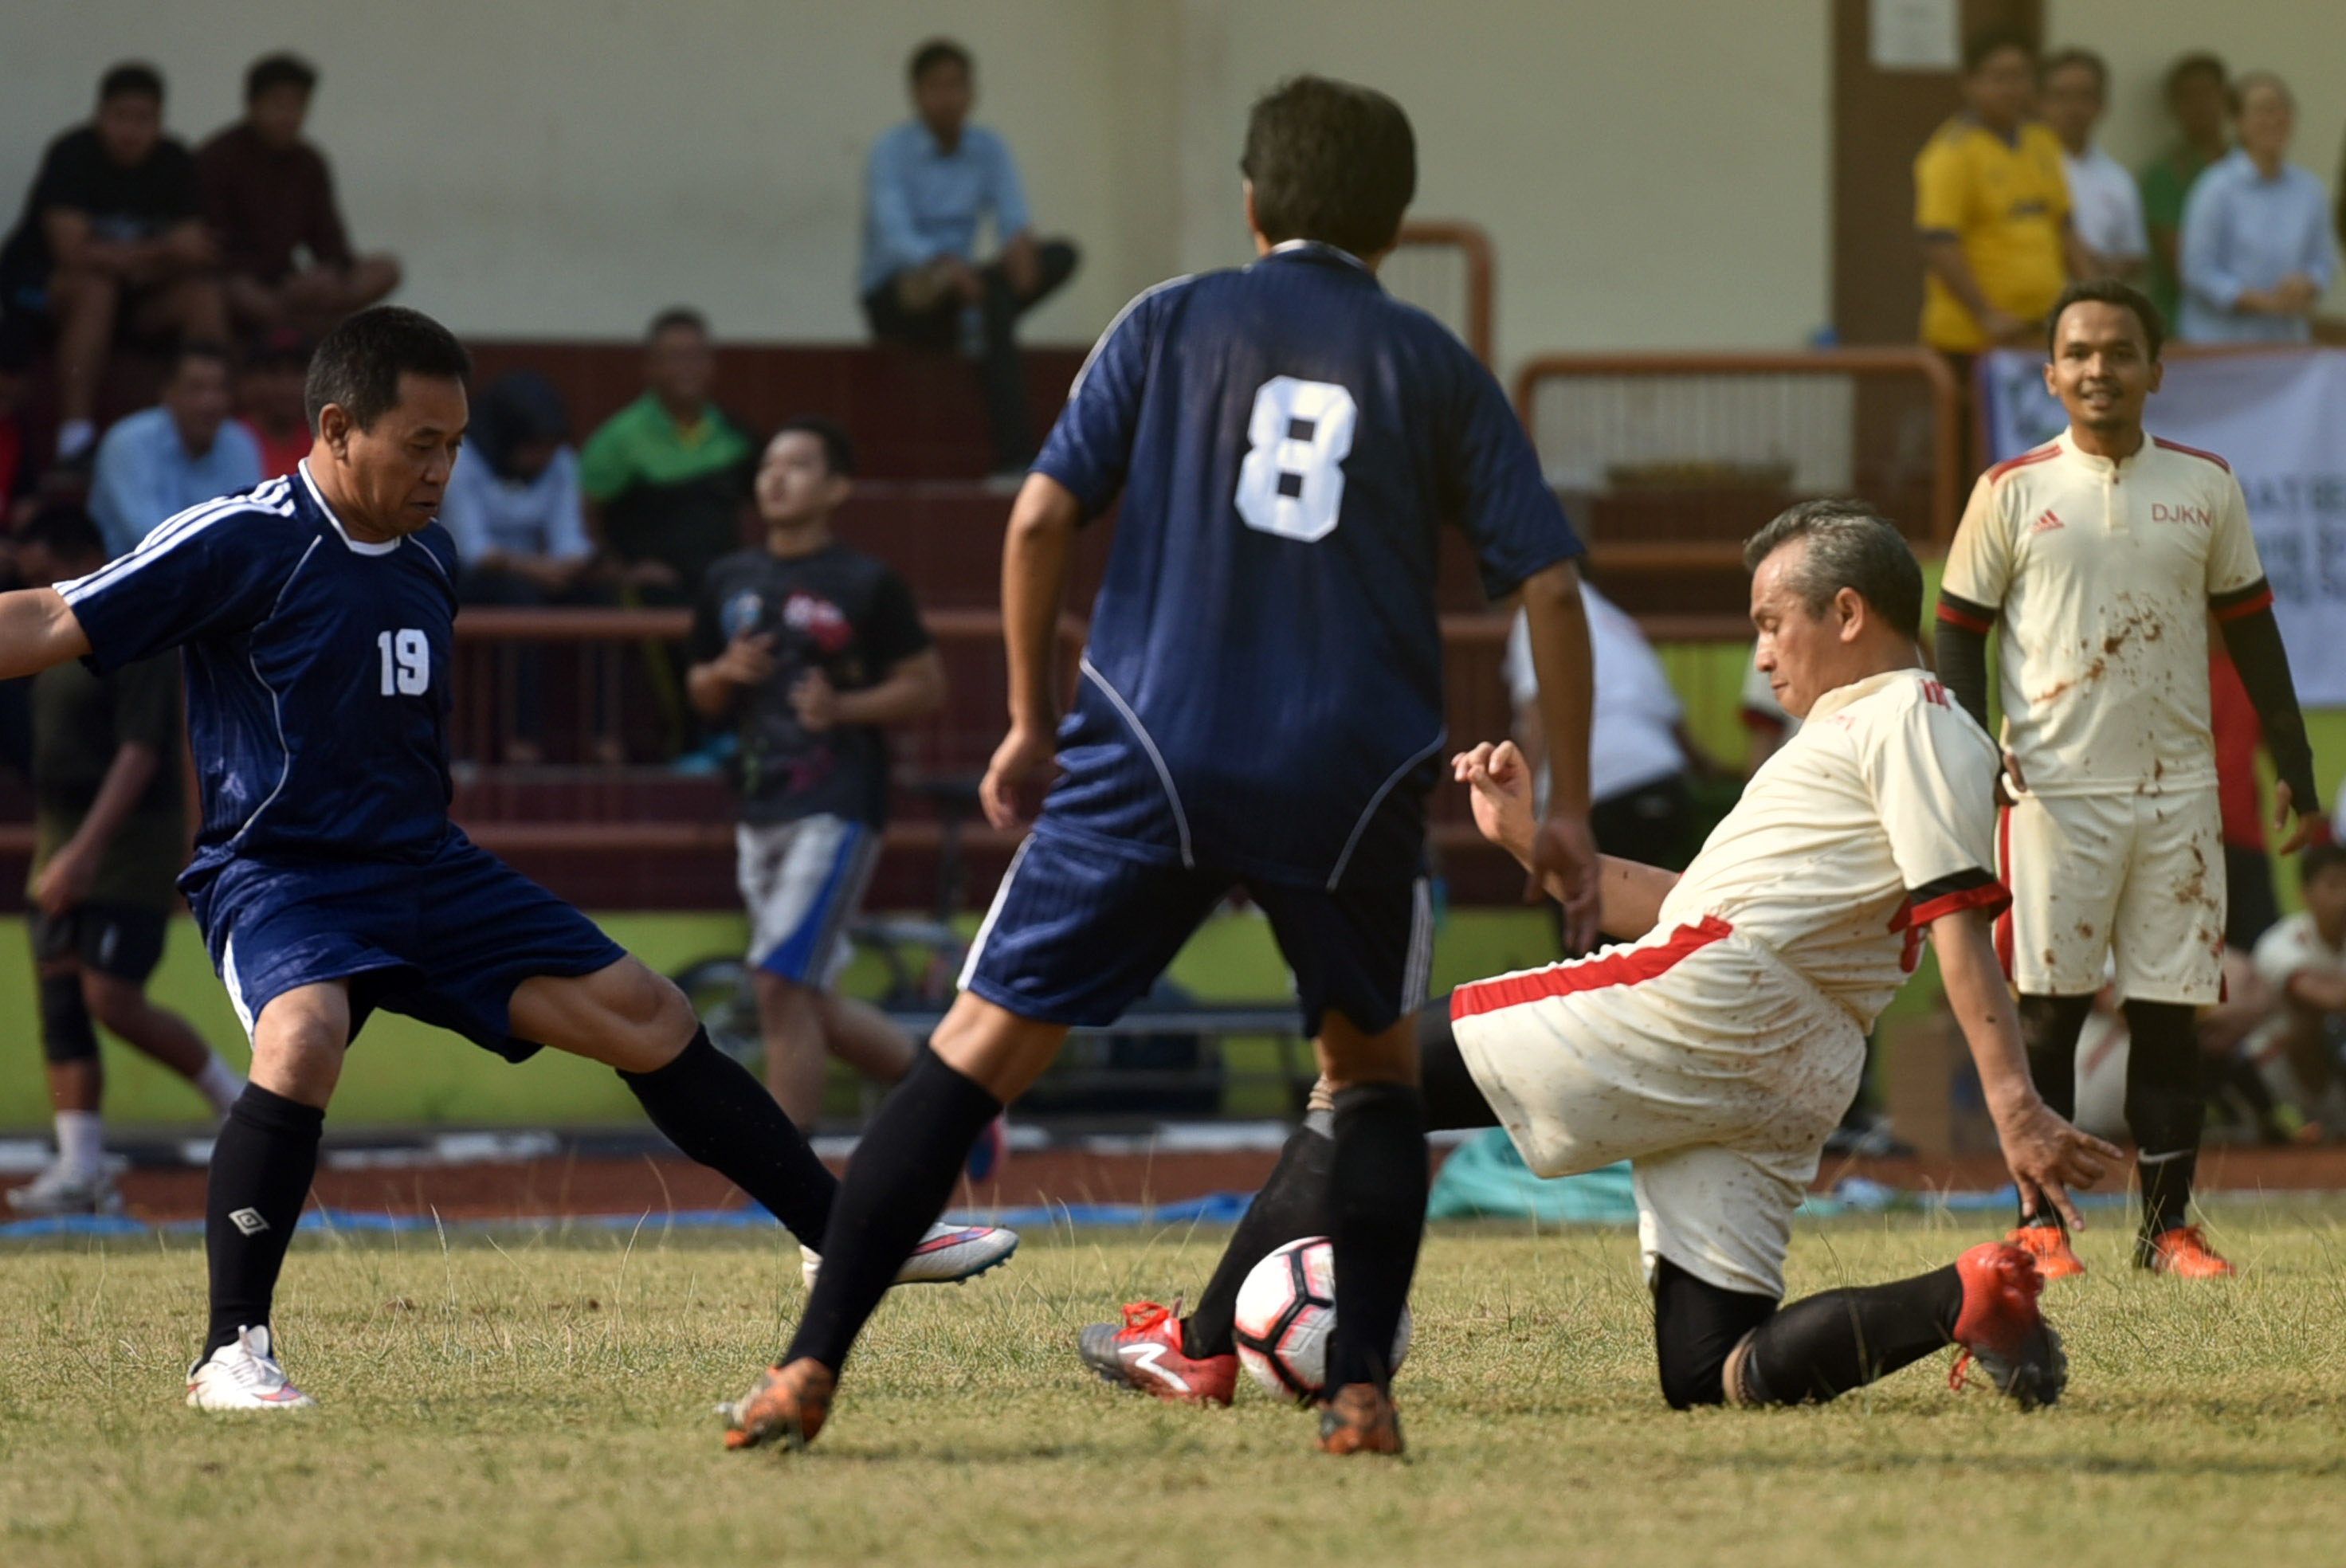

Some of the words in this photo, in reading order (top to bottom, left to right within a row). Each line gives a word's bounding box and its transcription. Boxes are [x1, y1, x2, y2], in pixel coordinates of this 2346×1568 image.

[1234, 374, 1358, 543] 8
[2152, 503, 2212, 527] DJKN
[378, 628, 430, 696] 19
